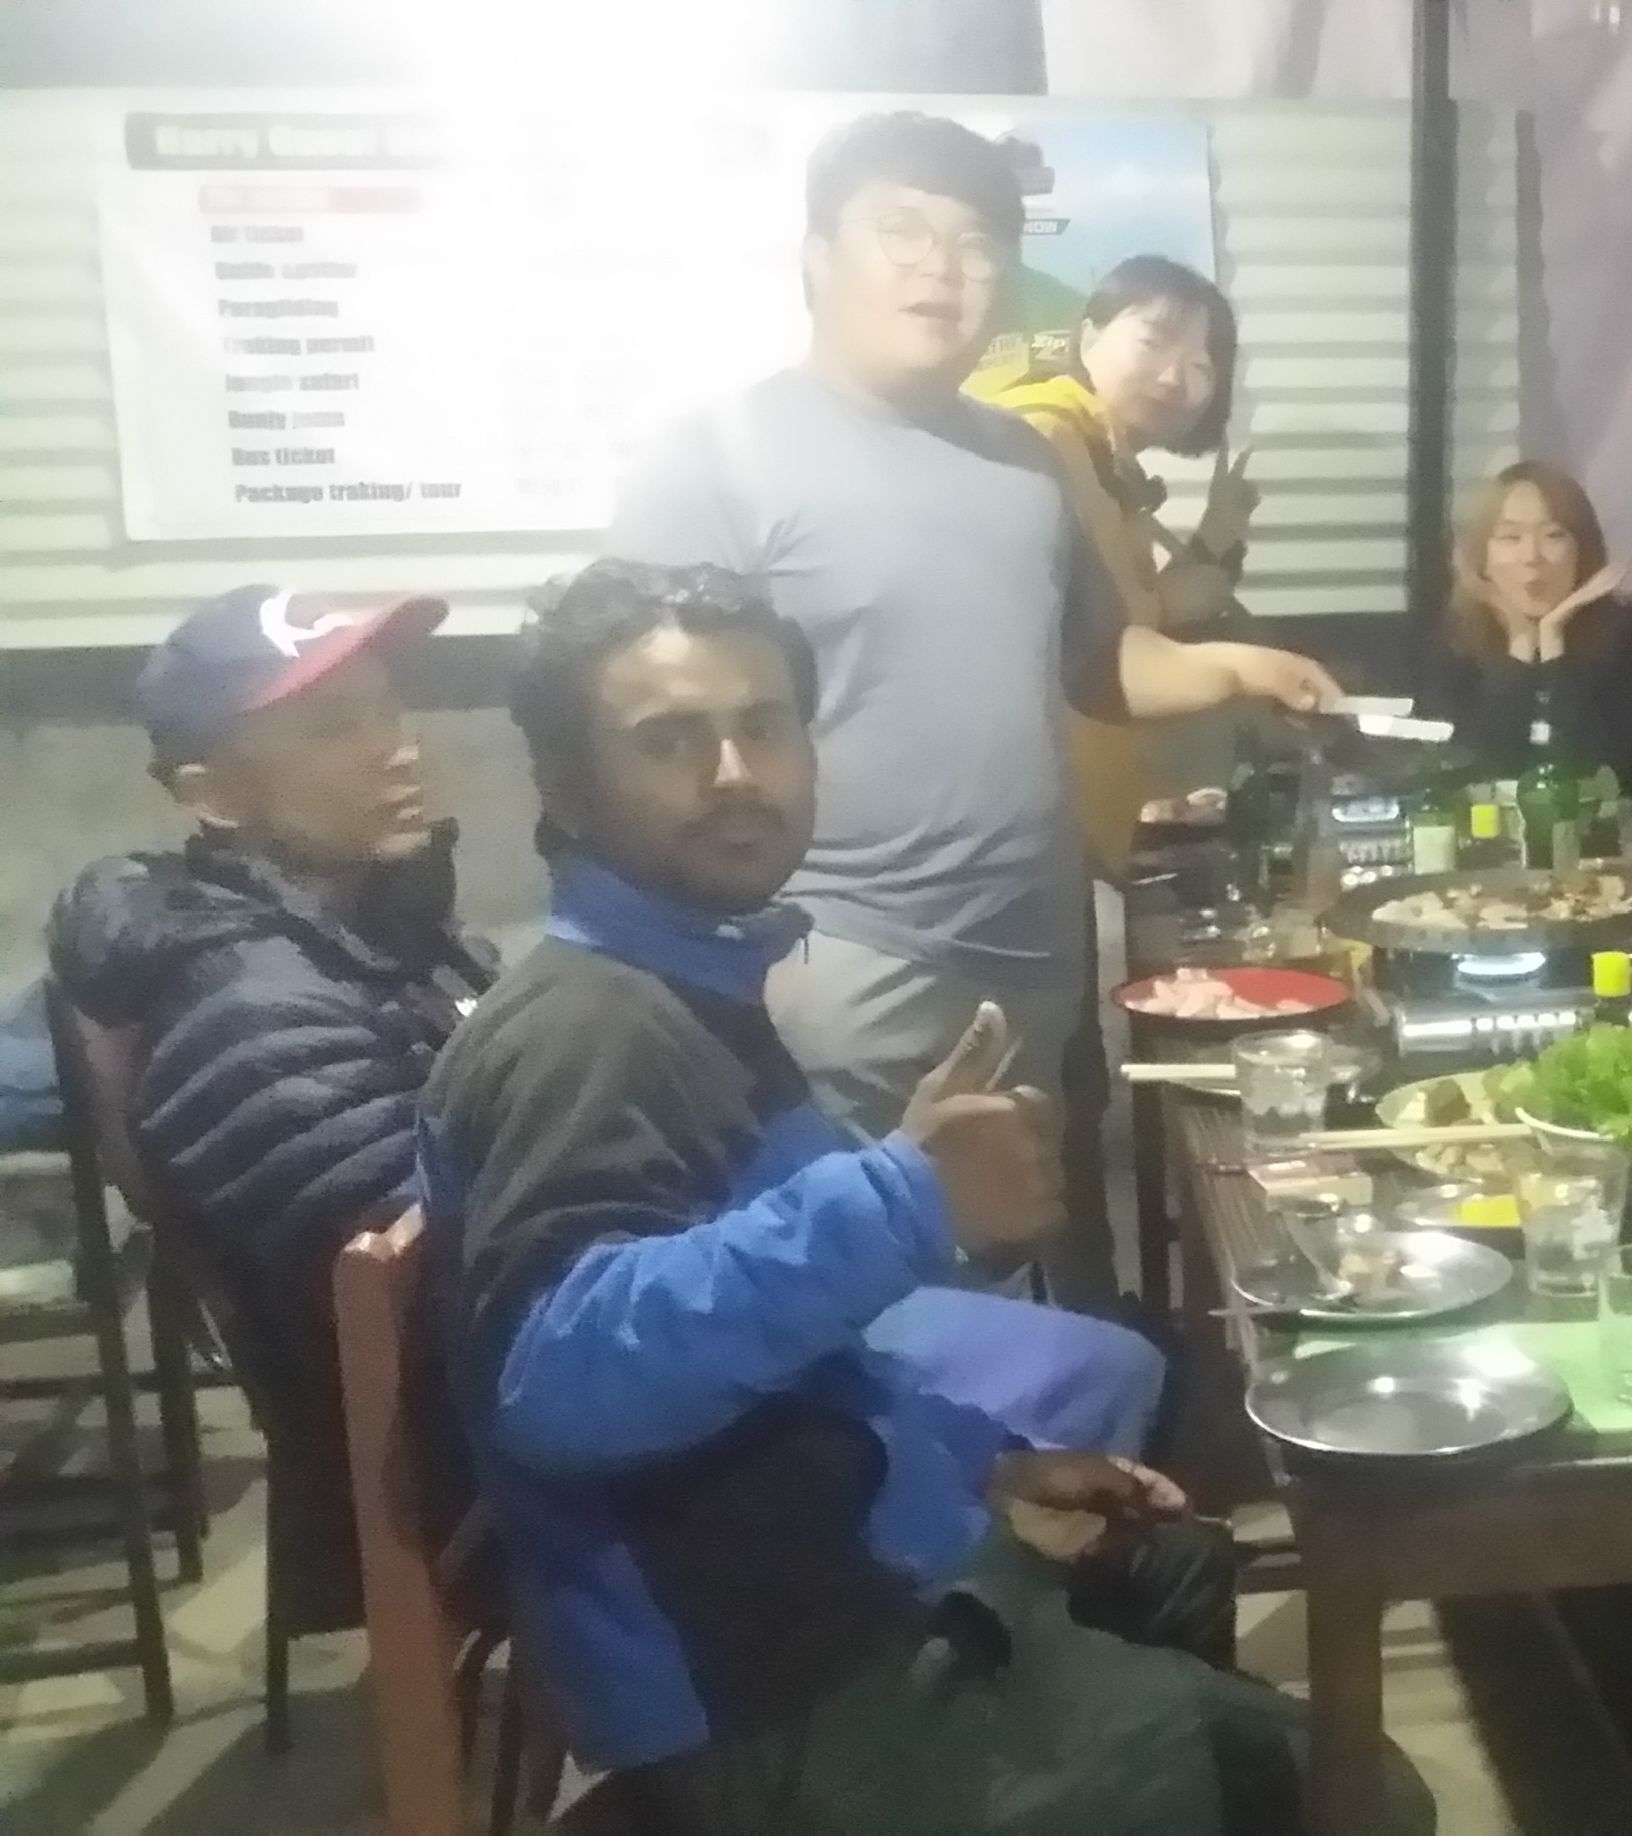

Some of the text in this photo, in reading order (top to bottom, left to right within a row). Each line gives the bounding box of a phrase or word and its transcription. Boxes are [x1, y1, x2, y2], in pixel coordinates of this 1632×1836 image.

[231, 447, 335, 465] Bus ticket
[420, 483, 462, 498] tour
